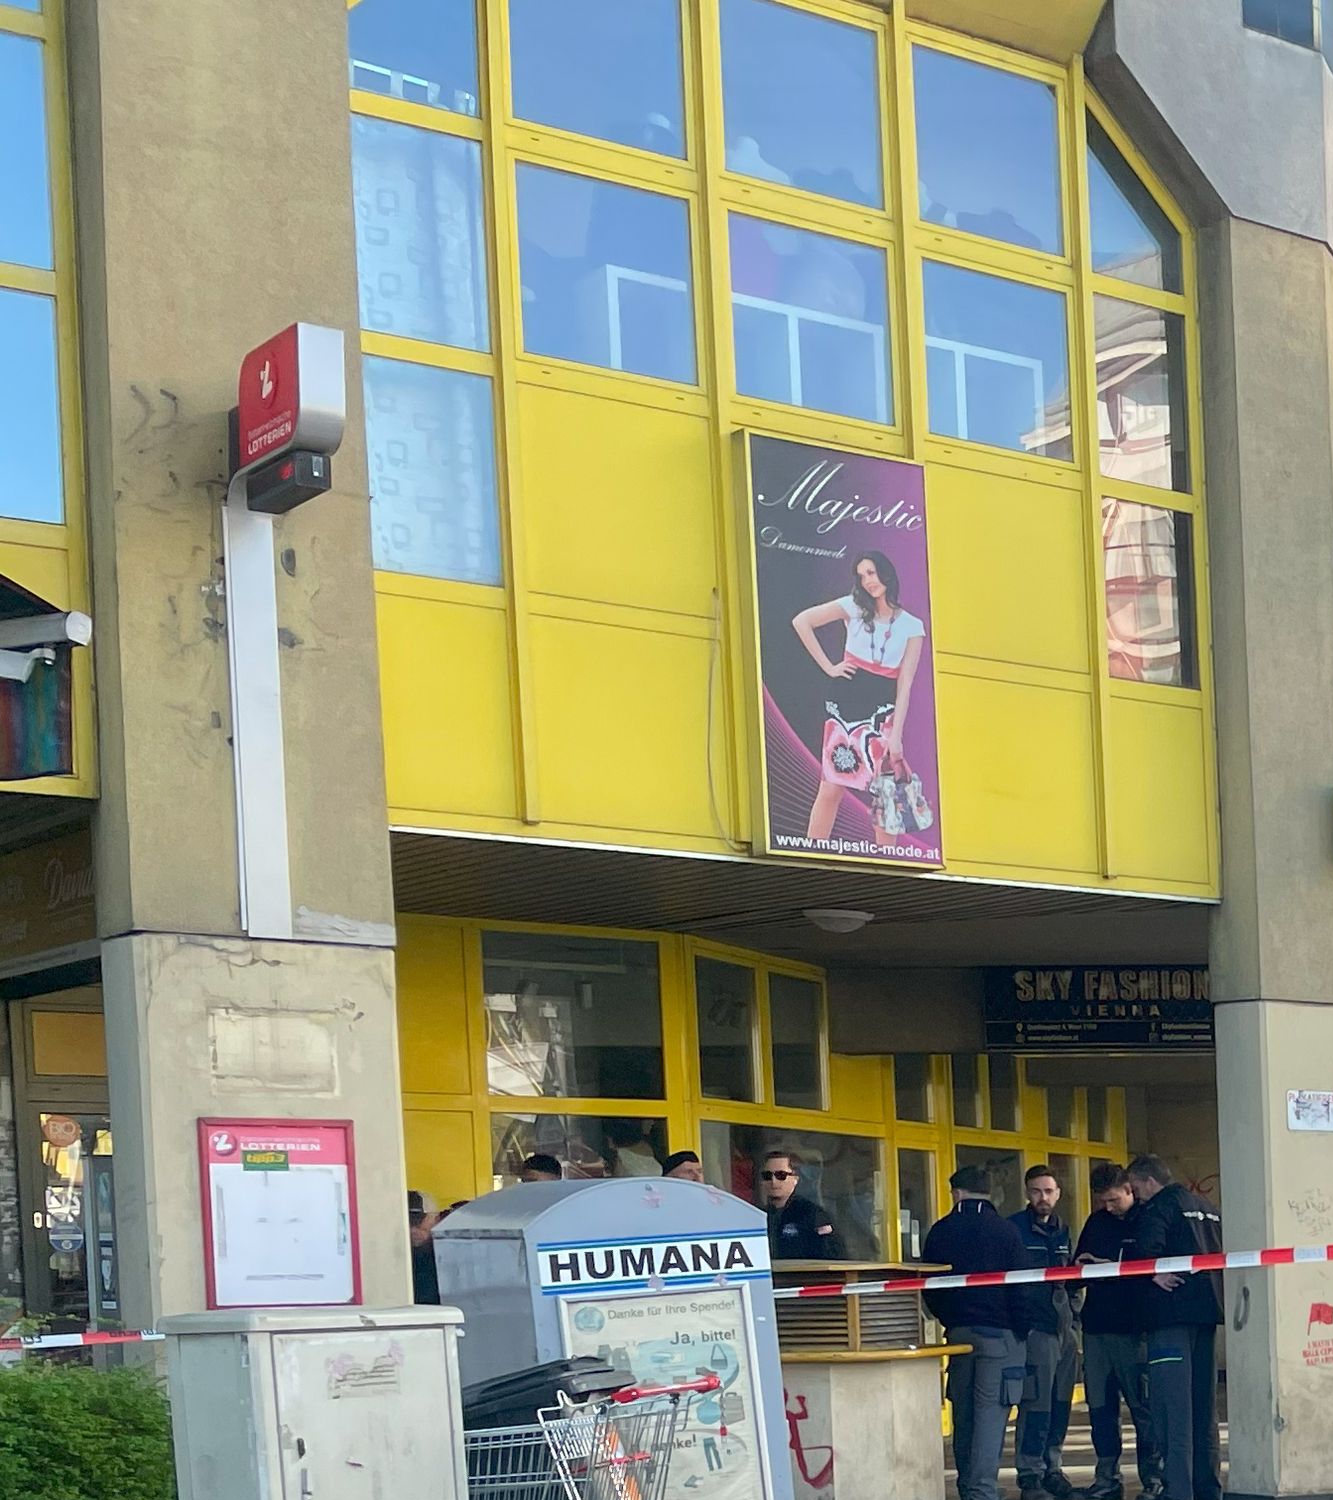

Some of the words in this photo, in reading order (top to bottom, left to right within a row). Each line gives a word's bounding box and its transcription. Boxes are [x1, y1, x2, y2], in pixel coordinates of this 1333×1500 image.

[247, 419, 292, 455] LOTTERIEN
[757, 459, 924, 534] Majestic
[775, 832, 941, 862] www.majestic-mode.at
[1013, 969, 1073, 1001] SKY
[1084, 969, 1211, 1001] FASHION
[1071, 1004, 1162, 1017] VIENNA
[240, 1142, 322, 1152] LOTTERIEN
[548, 1240, 754, 1284] HUMANA
[607, 1307, 645, 1321] Danke
[647, 1304, 662, 1318] für
[665, 1303, 687, 1316] Ihre
[690, 1299, 736, 1316] Spende!
[669, 1330, 696, 1347] Ja,
[701, 1328, 736, 1343] bitte!
